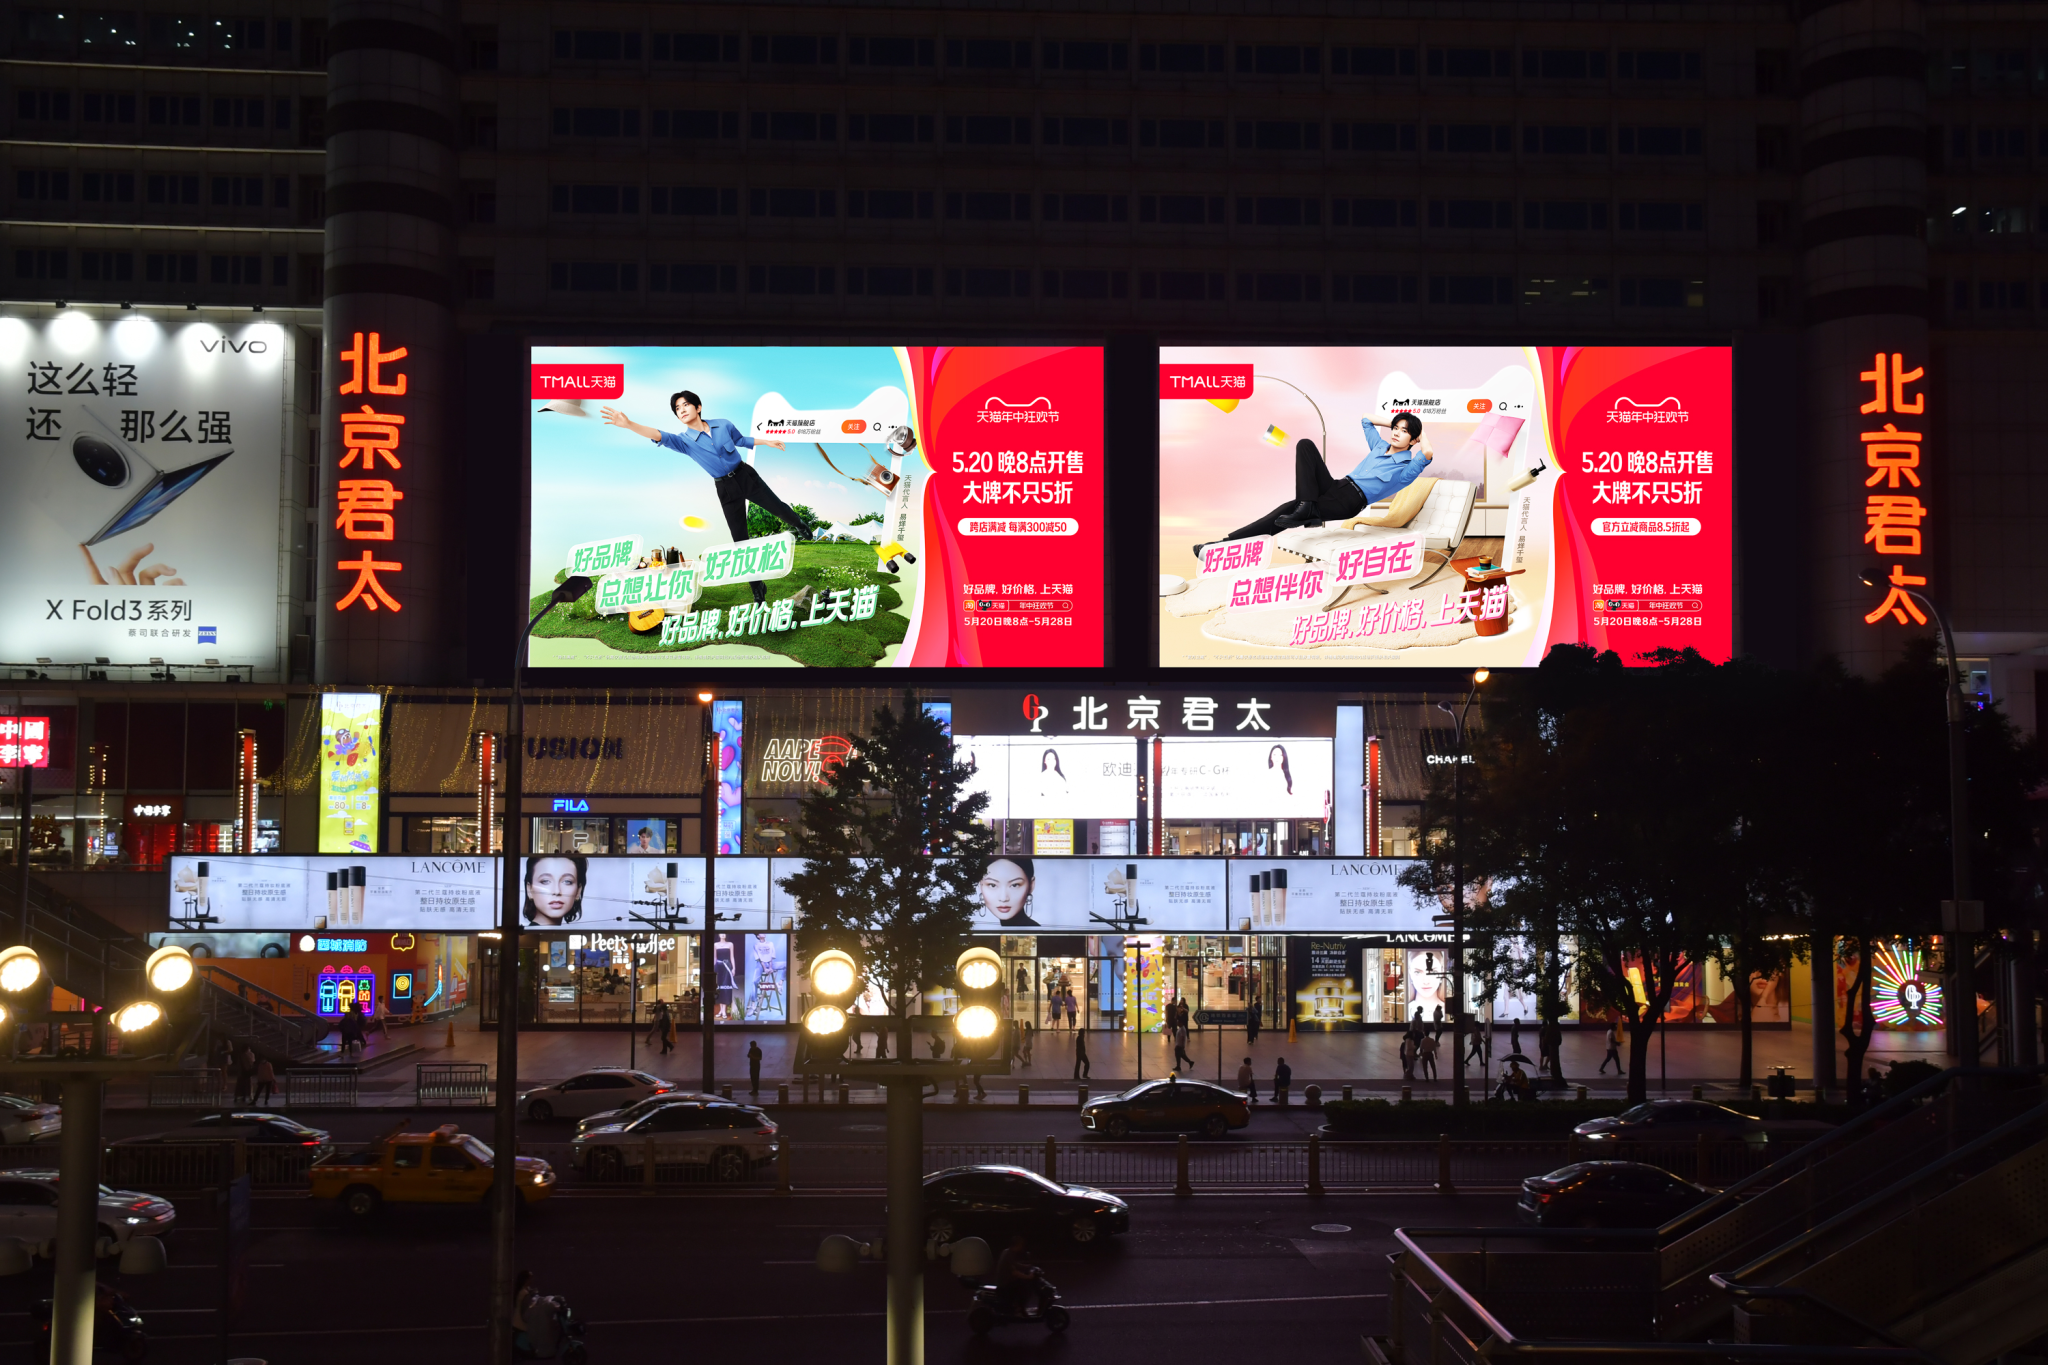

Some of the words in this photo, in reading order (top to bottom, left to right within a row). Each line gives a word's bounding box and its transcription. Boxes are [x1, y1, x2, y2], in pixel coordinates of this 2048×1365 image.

[200, 336, 267, 354] vivo
[27, 361, 138, 397] 这么轻
[26, 407, 62, 441] 还
[120, 409, 232, 445] 那么强
[976, 411, 1060, 423] 天猫年中狂欢节
[1606, 411, 1689, 423] 天猫年中狂欢节
[336, 332, 408, 613] 北京君太
[952, 451, 993, 473] 5.20
[998, 450, 1084, 474] 晚8点开售
[1582, 451, 1623, 473] 5.20
[1627, 450, 1713, 474] 晚8点开售
[963, 480, 1073, 504] 大牌不只5折
[1592, 480, 1703, 504] 大牌不只5折
[1860, 353, 1927, 625] 北京君太
[969, 521, 1007, 533] 跨店满减
[1008, 521, 1067, 533] 每满300减50
[1602, 521, 1690, 533] 官方立减商品8.5折起
[572, 540, 634, 573] 好品牌
[703, 540, 788, 582] 好放松
[1202, 540, 1265, 574] 好品牌
[1336, 540, 1416, 582] 好自在
[599, 569, 694, 608] 总想让你
[1229, 569, 1324, 608] 总想伴你
[46, 600, 63, 620] X
[128, 629, 191, 638] 蔡司联合研发
[1072, 695, 1271, 731] 北京君太
[763, 739, 823, 760] AAPE
[761, 761, 823, 783] NOW!
[1102, 762, 1138, 777] 欧迪
[553, 799, 589, 812] FILA
[412, 859, 486, 873] LANCÔME
[420, 897, 476, 905] 整日持妆原生感
[1340, 899, 1393, 907] 整日持妆原生感
[1311, 942, 1347, 950] Re-Nutriv
